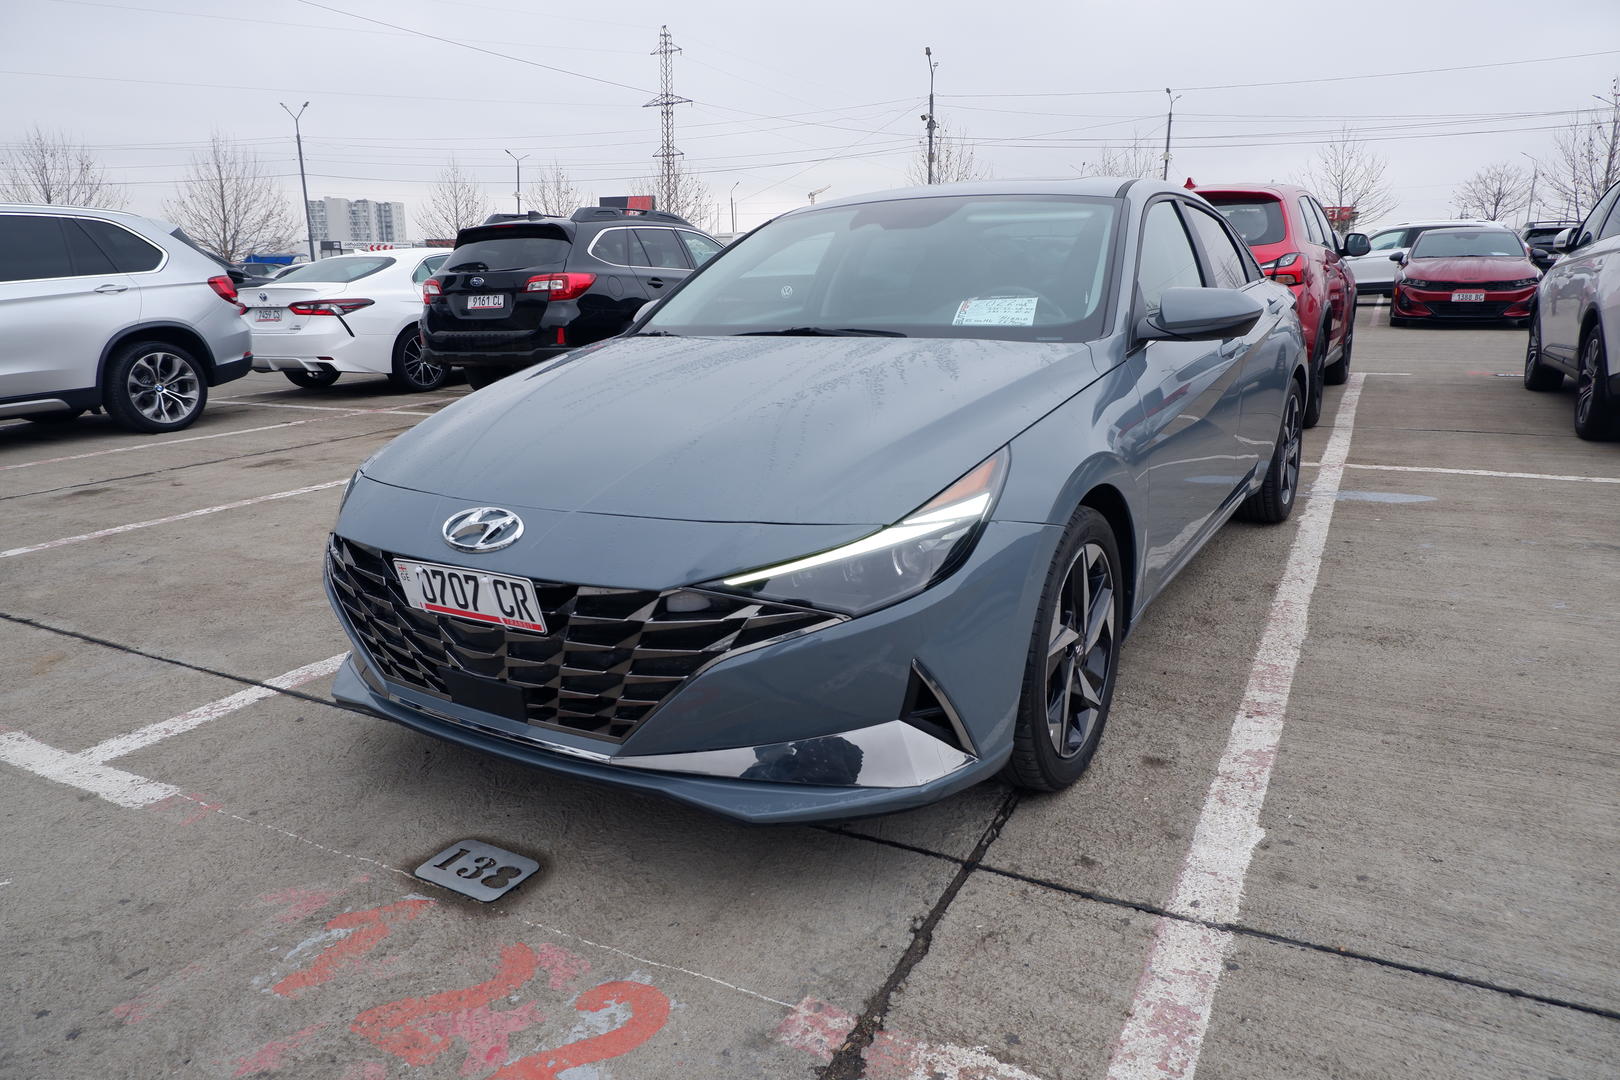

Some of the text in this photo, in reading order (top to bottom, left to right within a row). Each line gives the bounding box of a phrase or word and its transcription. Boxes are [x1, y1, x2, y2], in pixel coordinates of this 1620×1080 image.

[472, 295, 502, 306] 9161 CL
[416, 567, 536, 622] 0707 CR
[433, 848, 522, 889] 138
